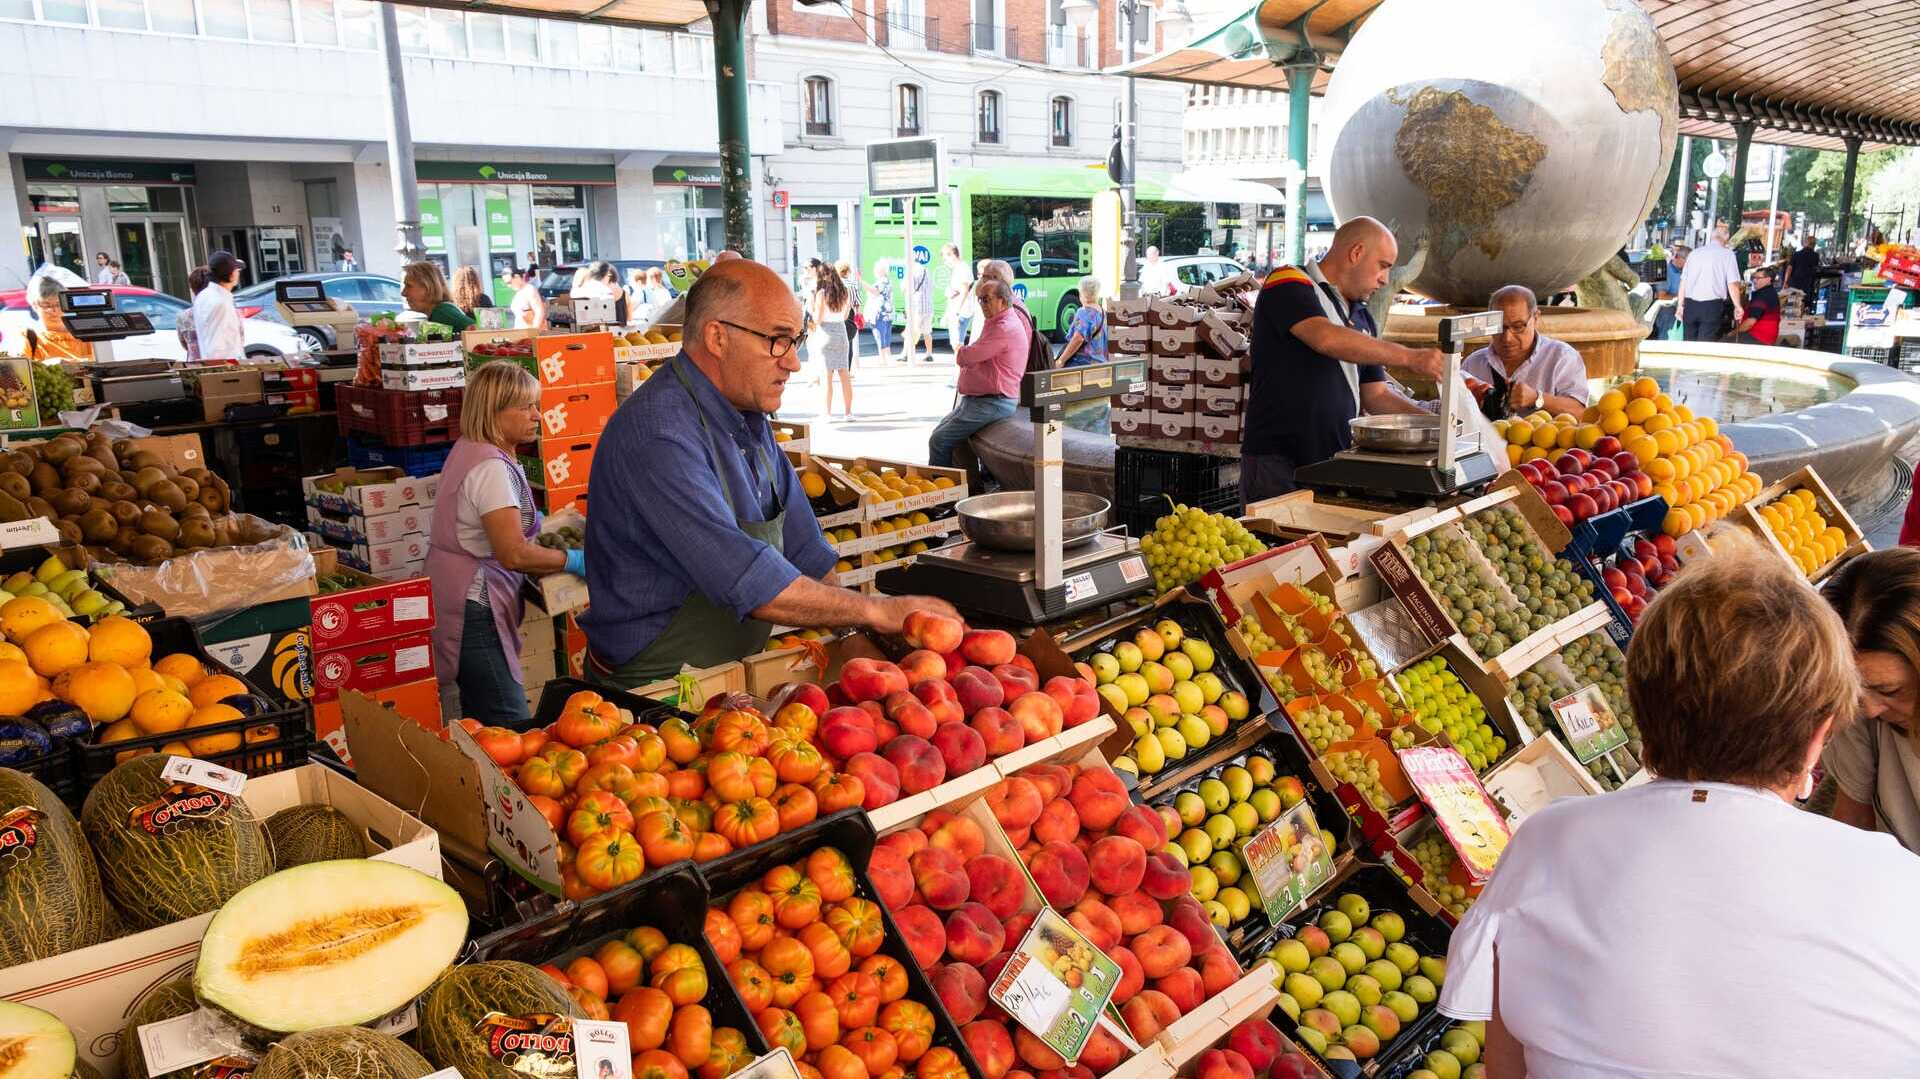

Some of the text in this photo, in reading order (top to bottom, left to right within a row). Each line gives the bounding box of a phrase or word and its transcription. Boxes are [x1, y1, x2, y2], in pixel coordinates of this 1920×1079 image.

[498, 171, 547, 182] Unicaja Banco
[154, 795, 215, 824] BOLLO
[506, 1031, 571, 1052] BOLLO
[590, 1030, 615, 1040] BOLLO
